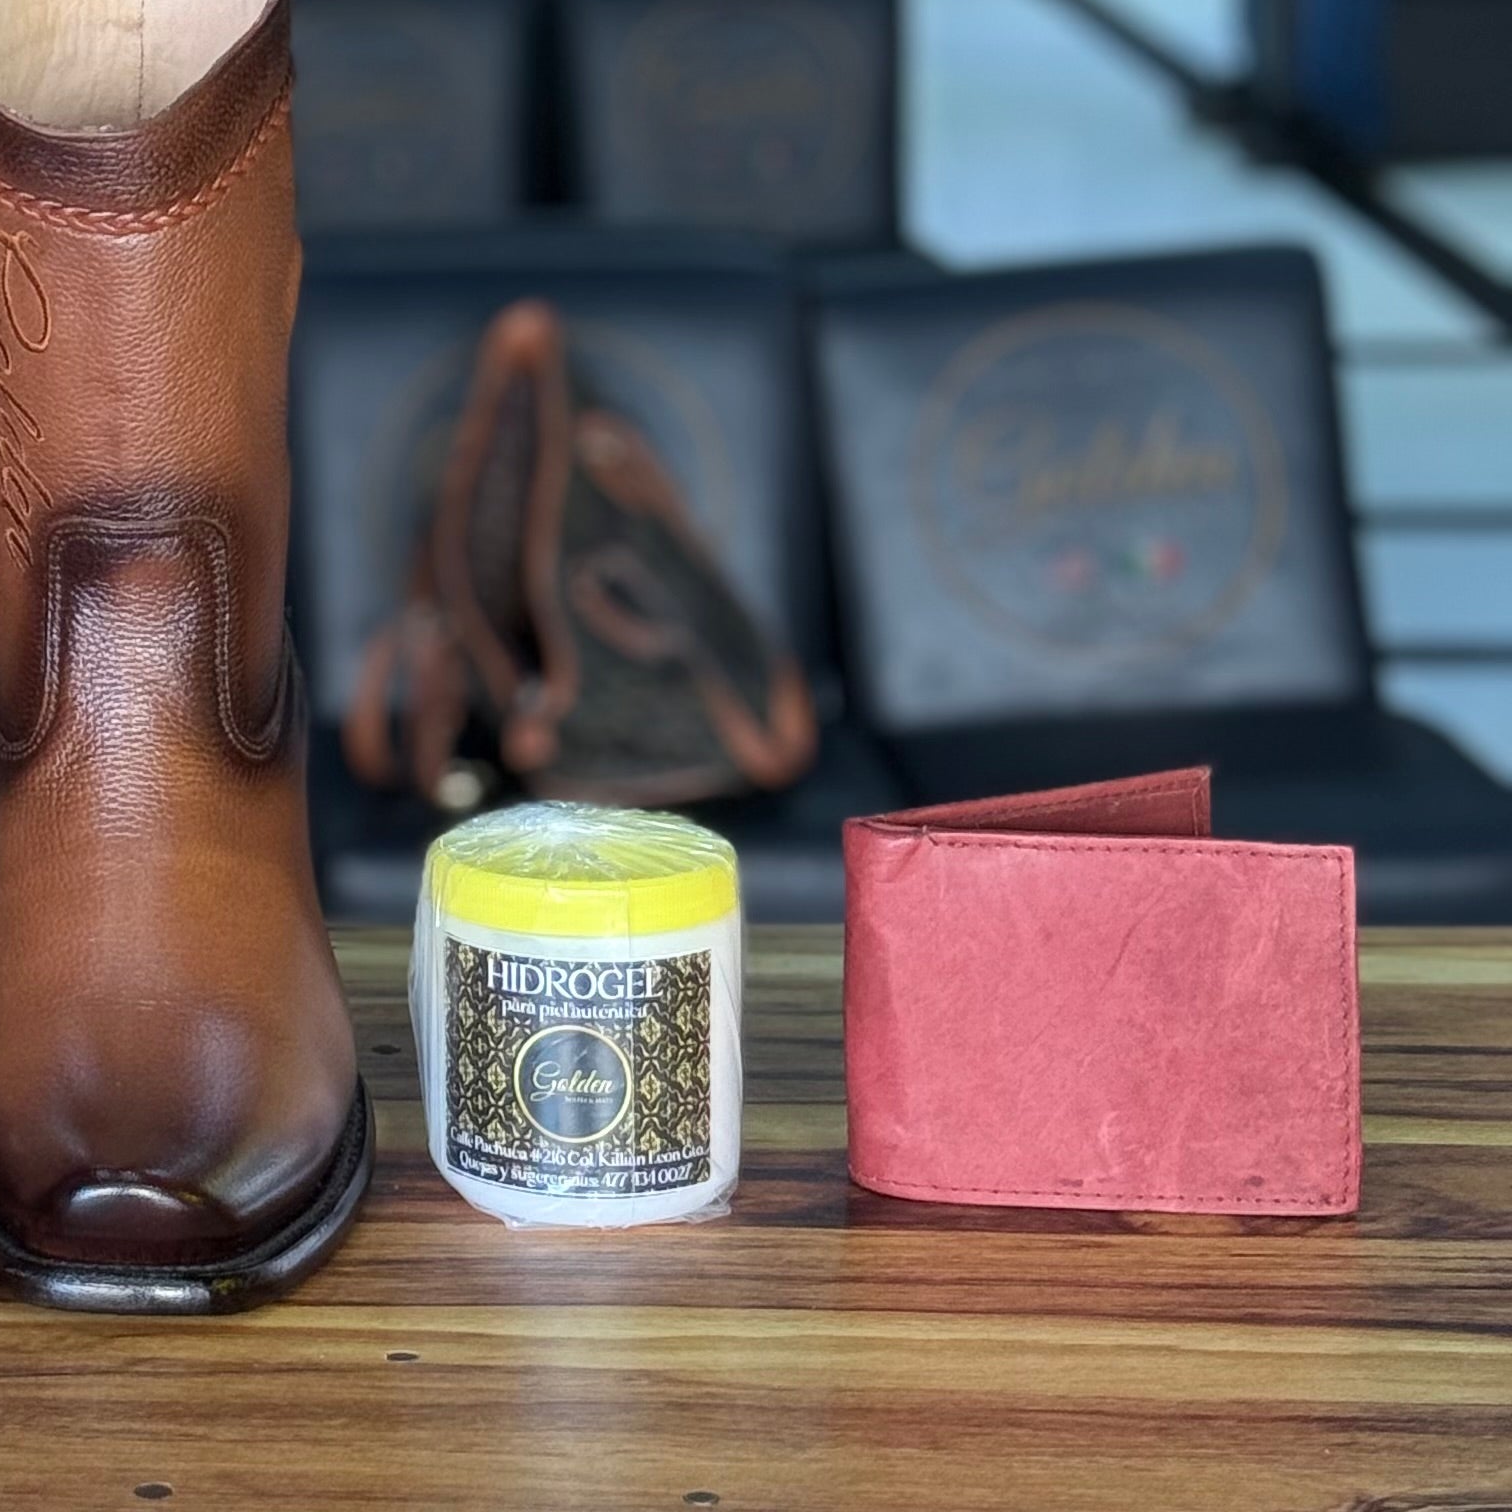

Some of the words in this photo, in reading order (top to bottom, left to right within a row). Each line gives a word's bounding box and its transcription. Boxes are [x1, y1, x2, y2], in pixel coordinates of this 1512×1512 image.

[488, 958, 664, 1000] HIDROGEL
[501, 998, 536, 1018] para
[530, 1060, 614, 1103] Golden
[499, 1165, 509, 1181] y
